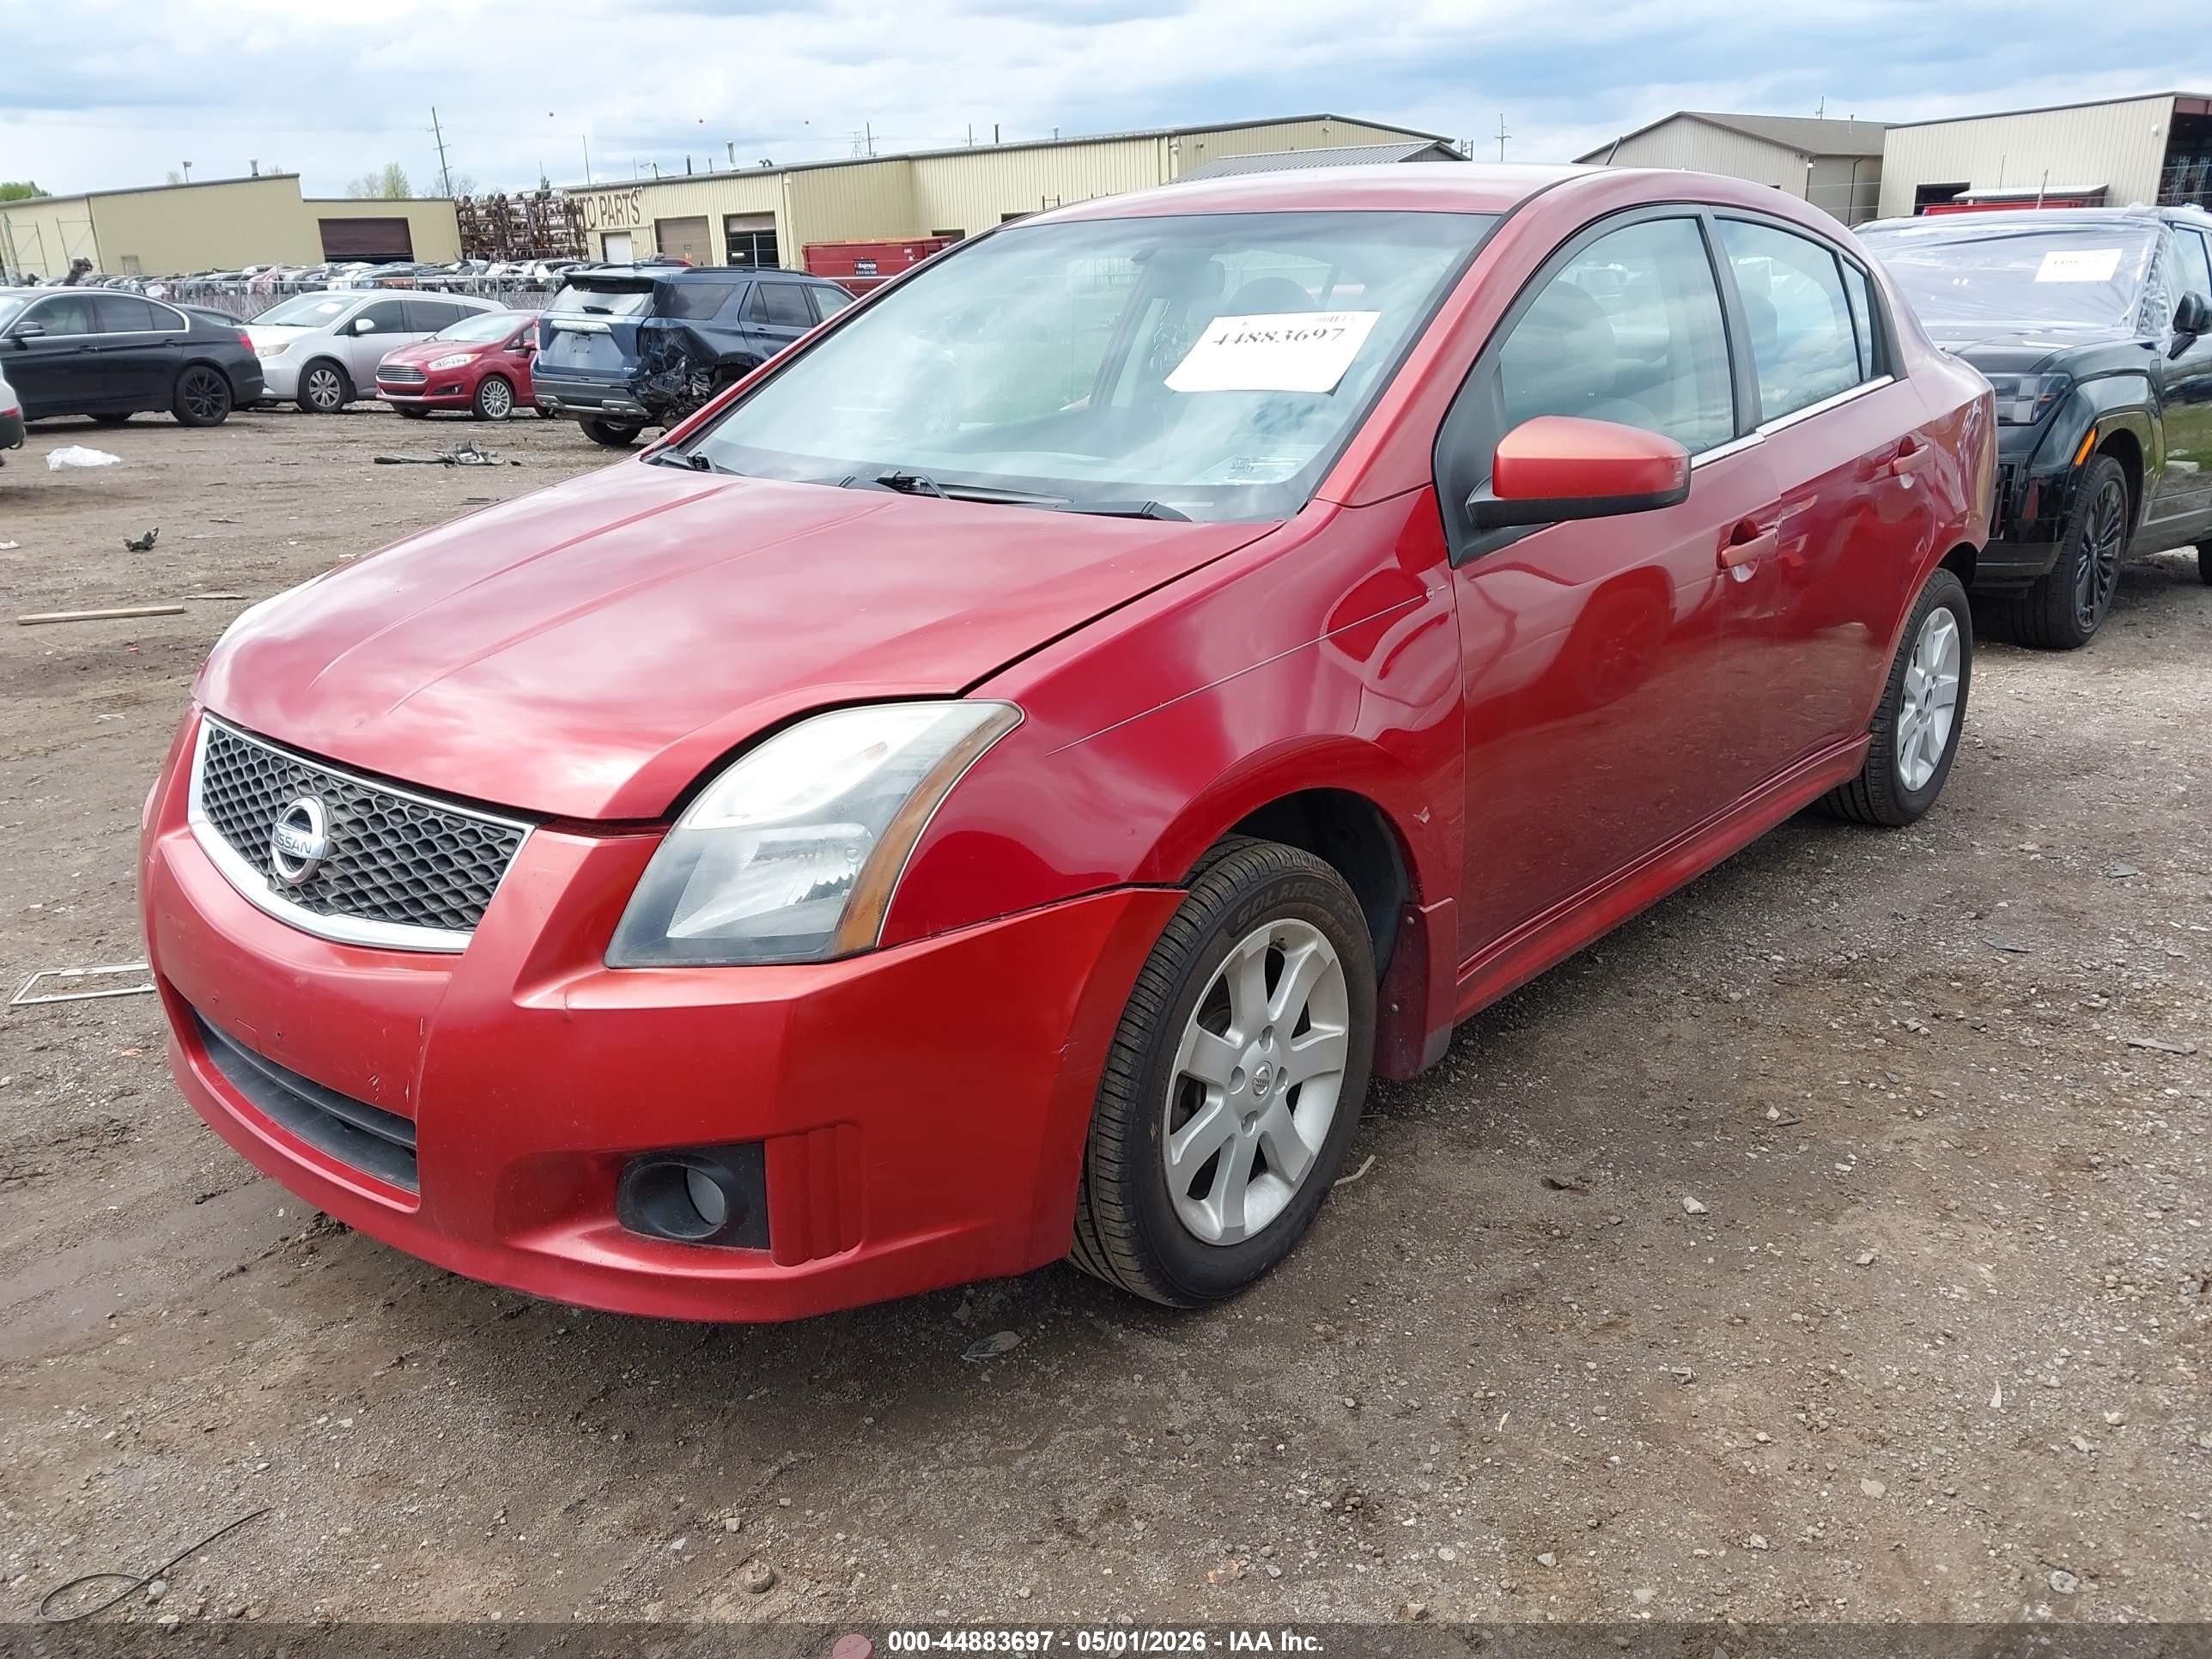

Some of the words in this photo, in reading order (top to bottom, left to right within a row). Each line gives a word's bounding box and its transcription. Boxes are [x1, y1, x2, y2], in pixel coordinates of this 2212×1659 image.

[599, 191, 641, 227] PARTS
[1212, 327, 1346, 346] 44883697
[1237, 881, 1333, 927] SOLARUS
